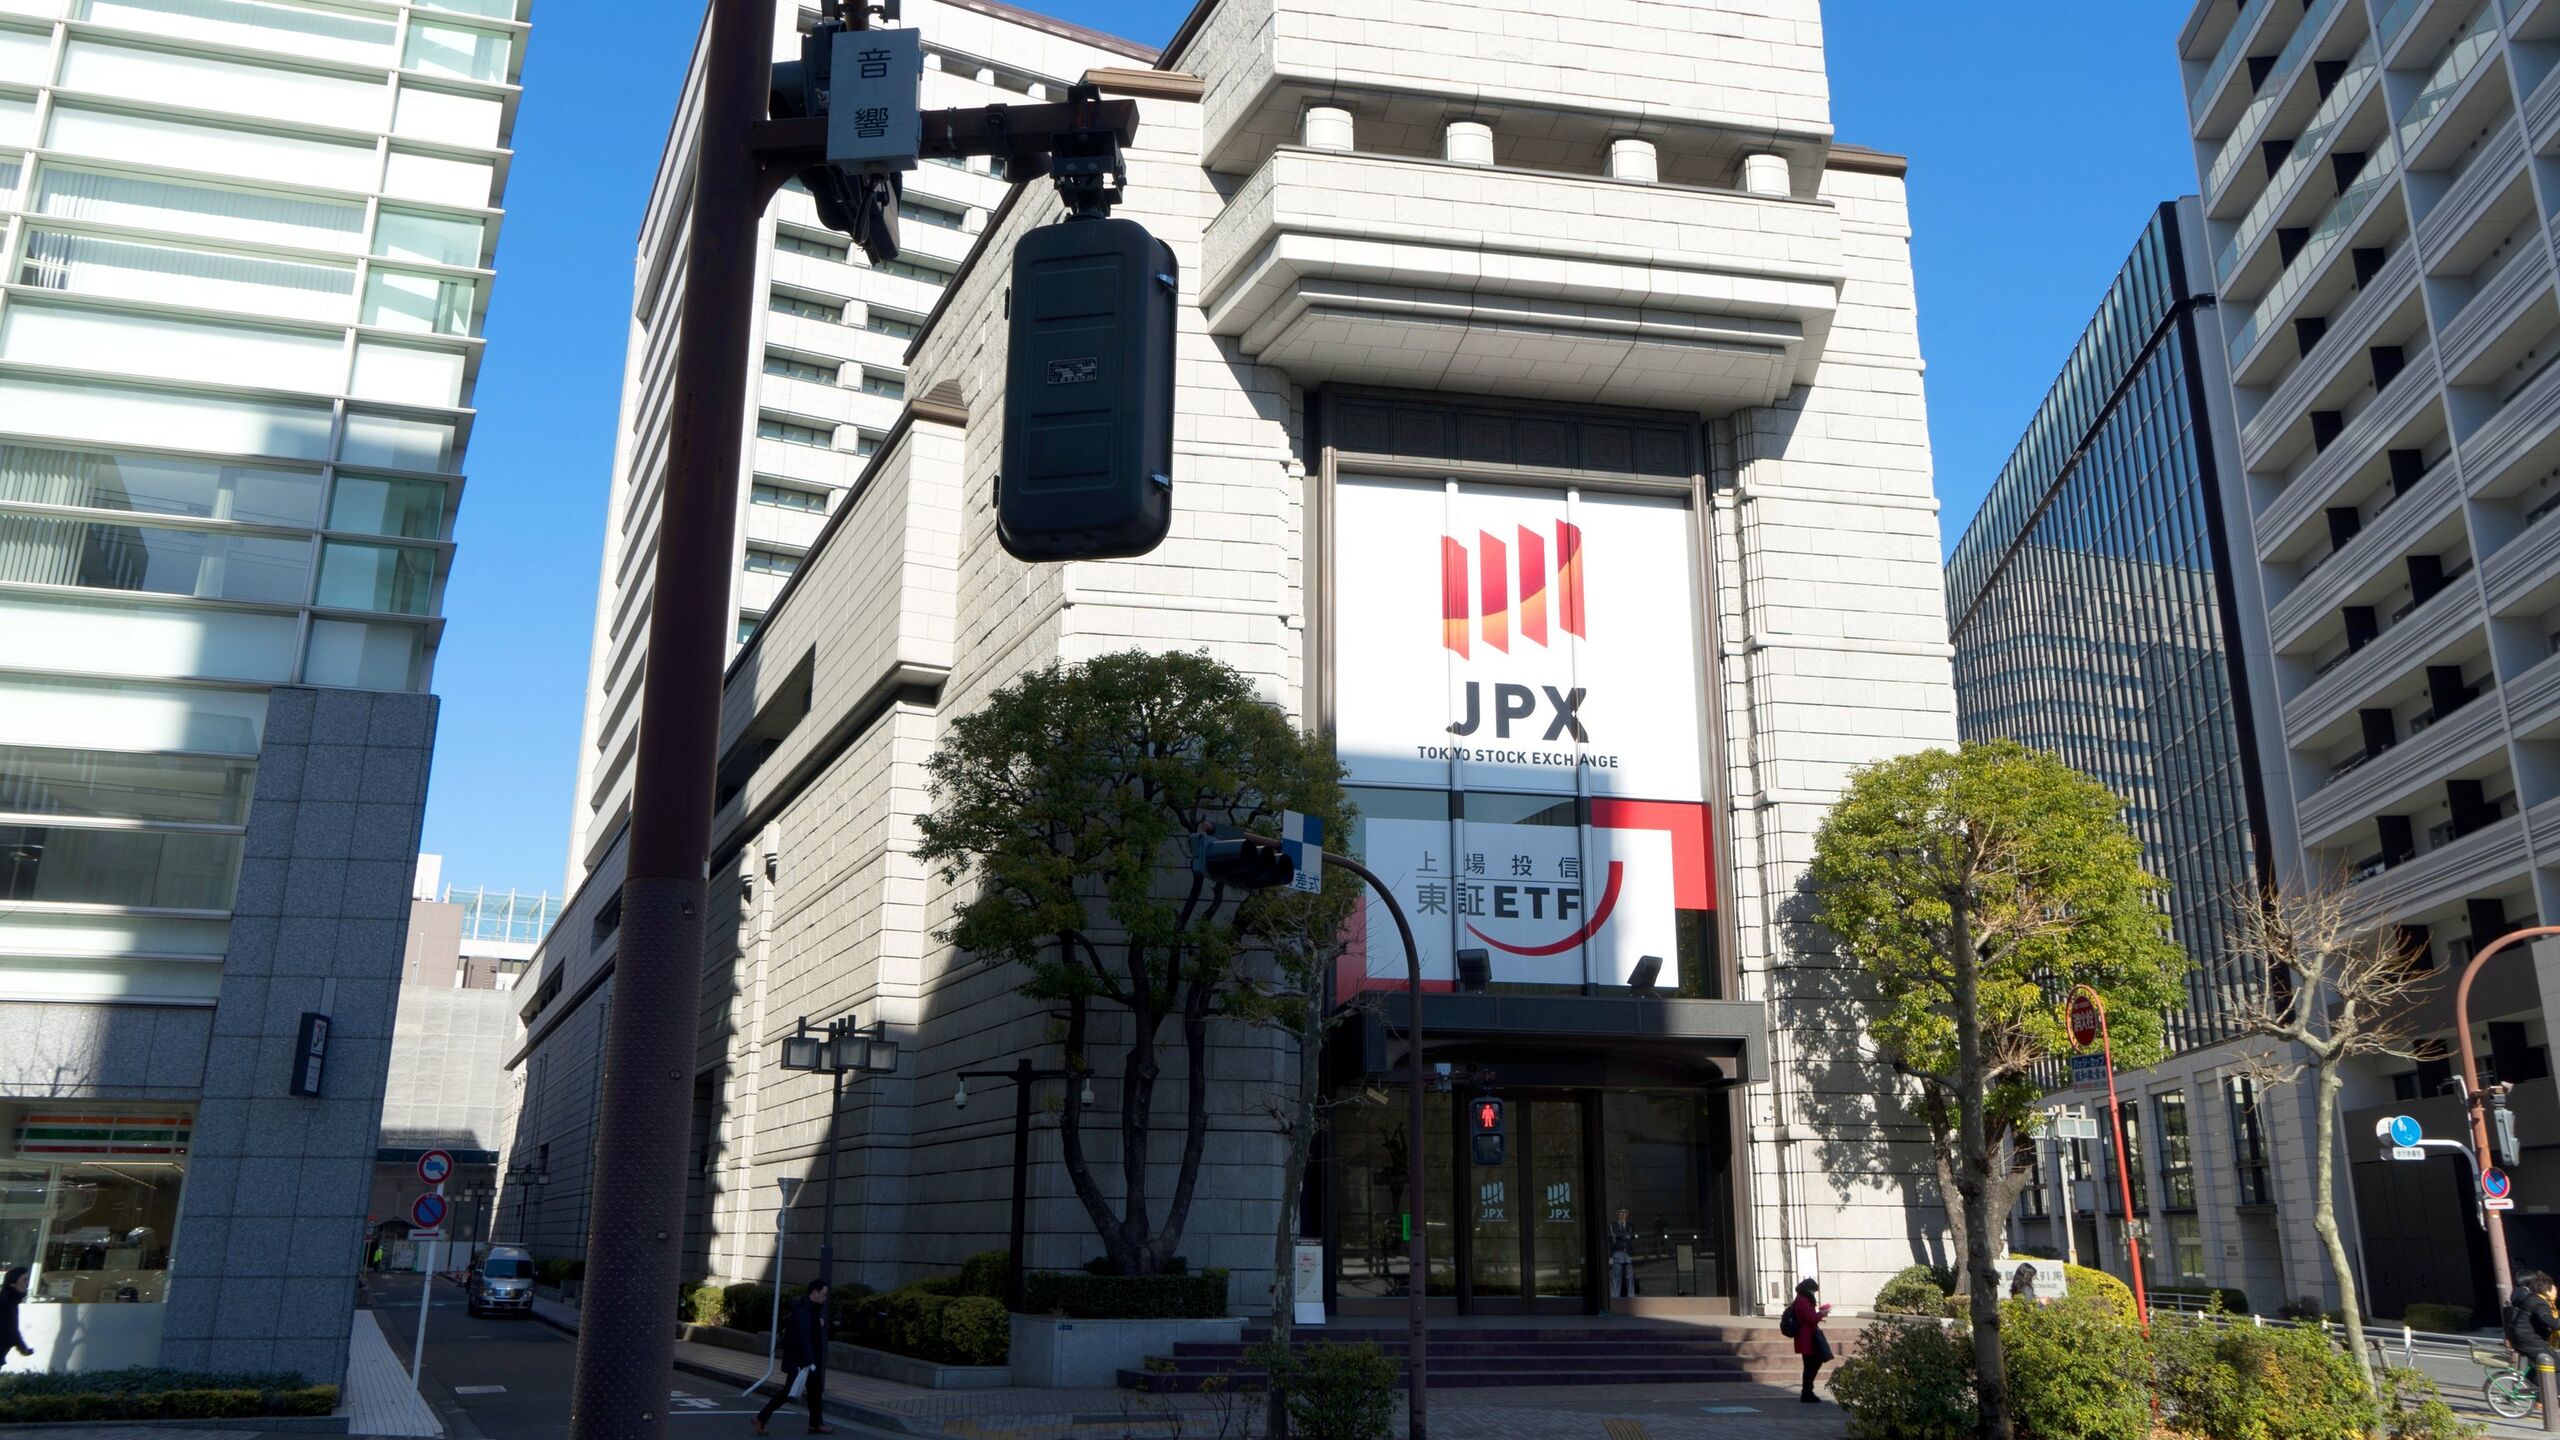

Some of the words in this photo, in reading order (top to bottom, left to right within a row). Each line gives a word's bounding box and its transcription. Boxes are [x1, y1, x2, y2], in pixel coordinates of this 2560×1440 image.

[856, 48, 892, 138] 音響
[1445, 681, 1590, 744] JPX
[1417, 746, 1471, 762] TOKYO
[1475, 749, 1527, 764] STOCK
[1532, 752, 1619, 768] EXCHANGE
[1416, 850, 1579, 879] 上場投信
[1288, 871, 1321, 893] 差式
[1416, 882, 1582, 921] 東証ETF
[1482, 1207, 1504, 1219] JPX
[1548, 1207, 1571, 1220] JPX
